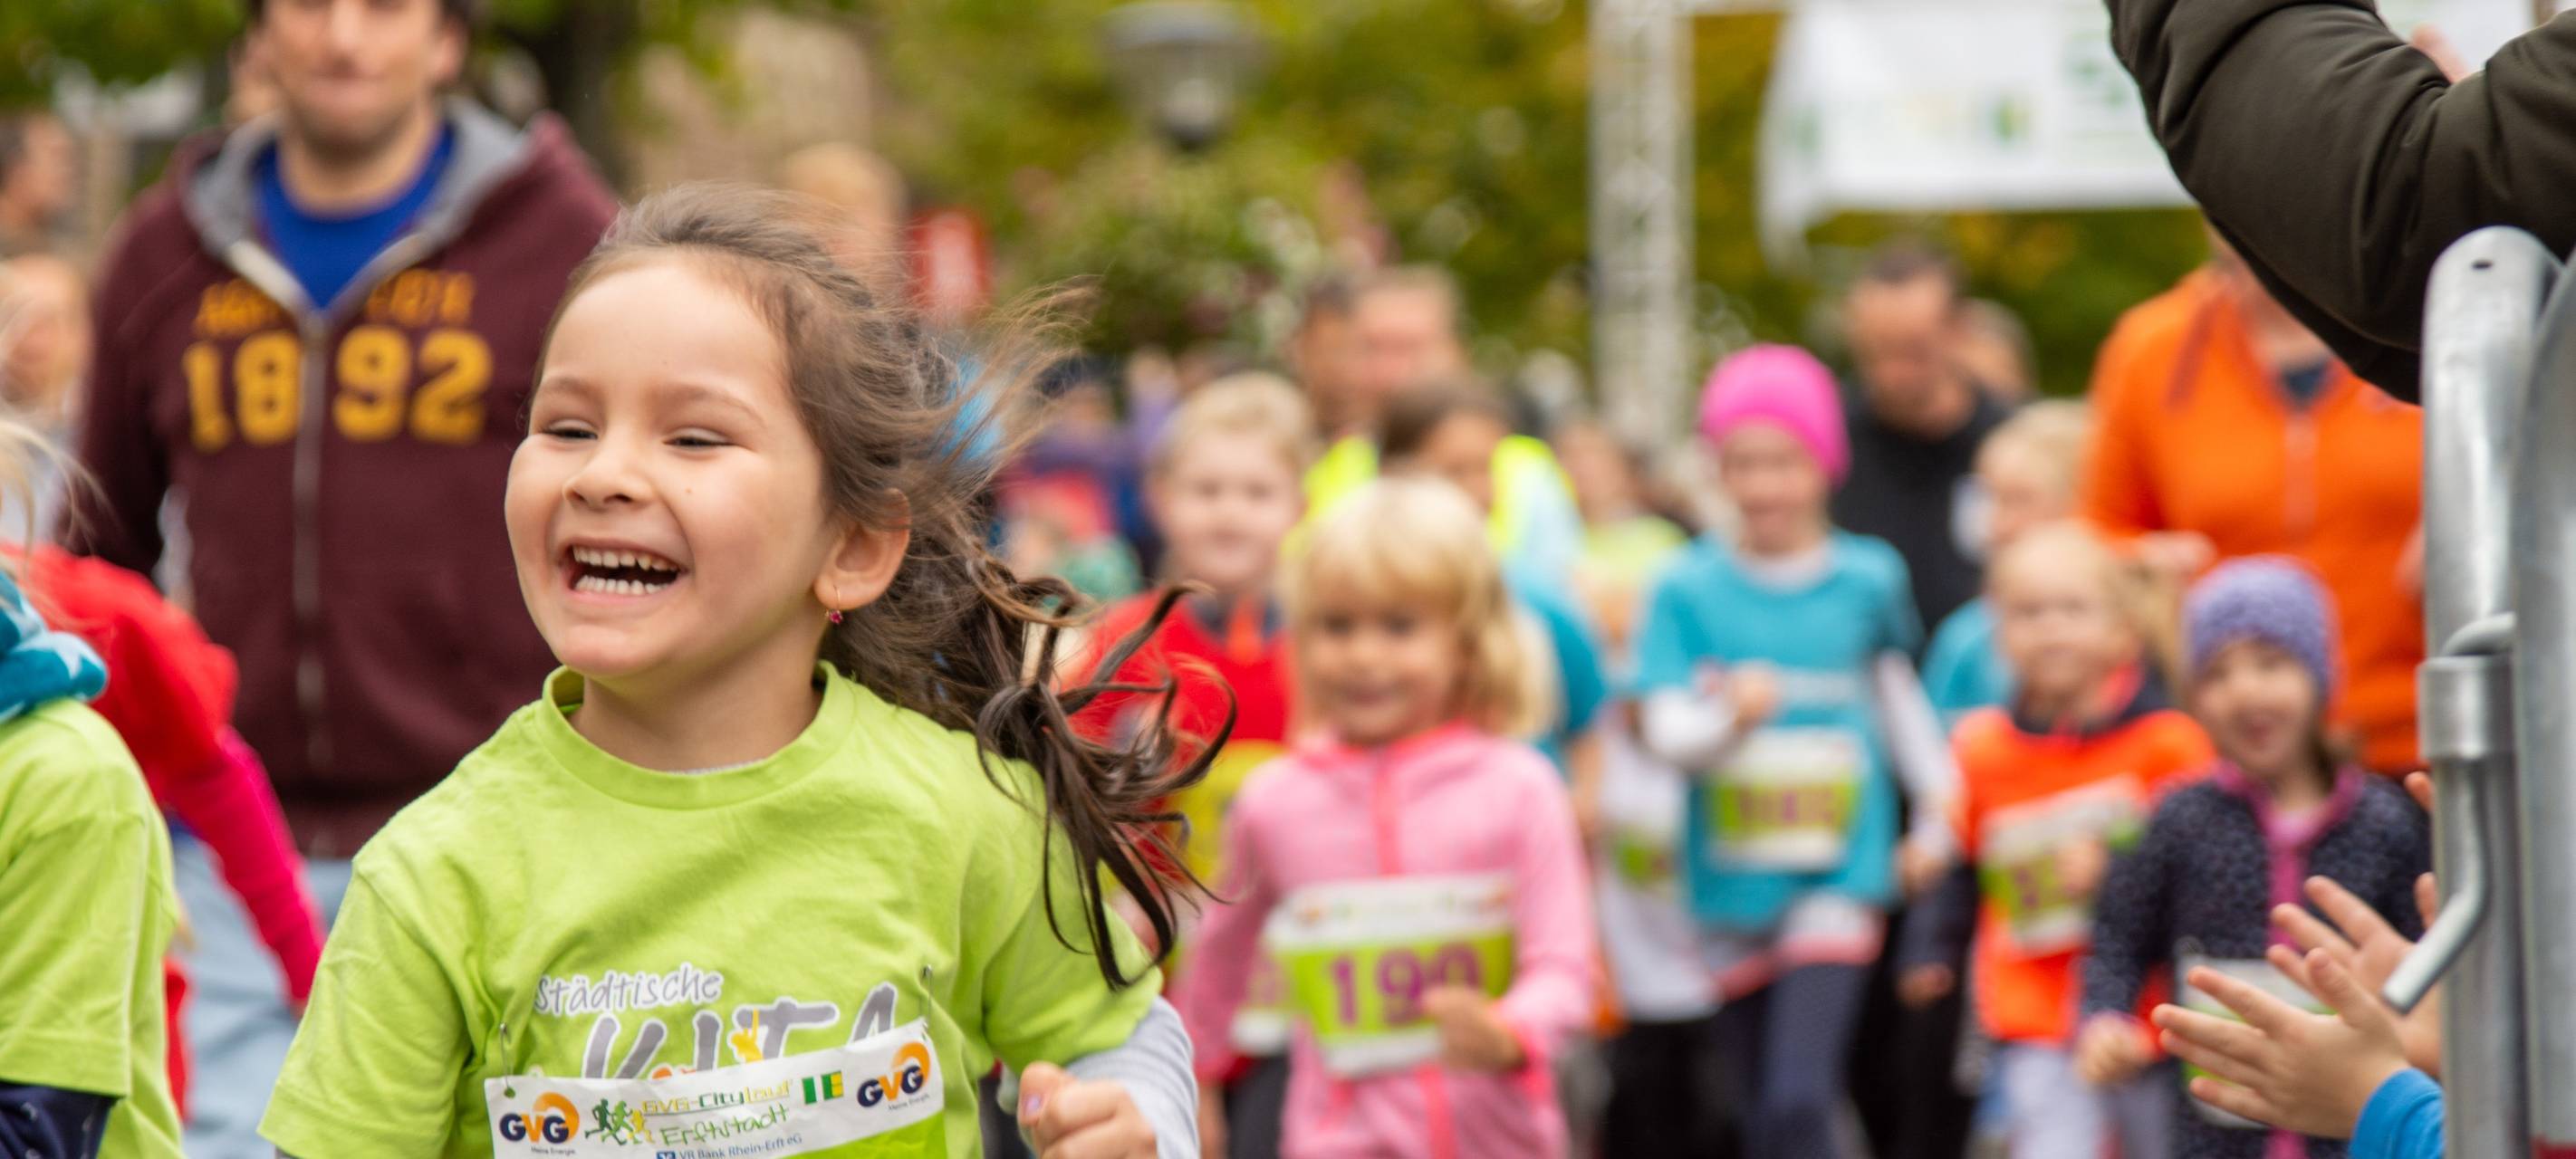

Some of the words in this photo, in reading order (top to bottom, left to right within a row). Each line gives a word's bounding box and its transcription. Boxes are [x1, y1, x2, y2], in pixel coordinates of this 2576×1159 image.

[185, 323, 492, 450] 1892
[536, 965, 721, 1012] Städtische
[857, 1066, 924, 1107] GVG
[500, 1113, 569, 1145] GVG
[697, 1148, 724, 1159] Bank
[728, 1137, 784, 1156] Rhein-Erft
[786, 1134, 803, 1146] eG
